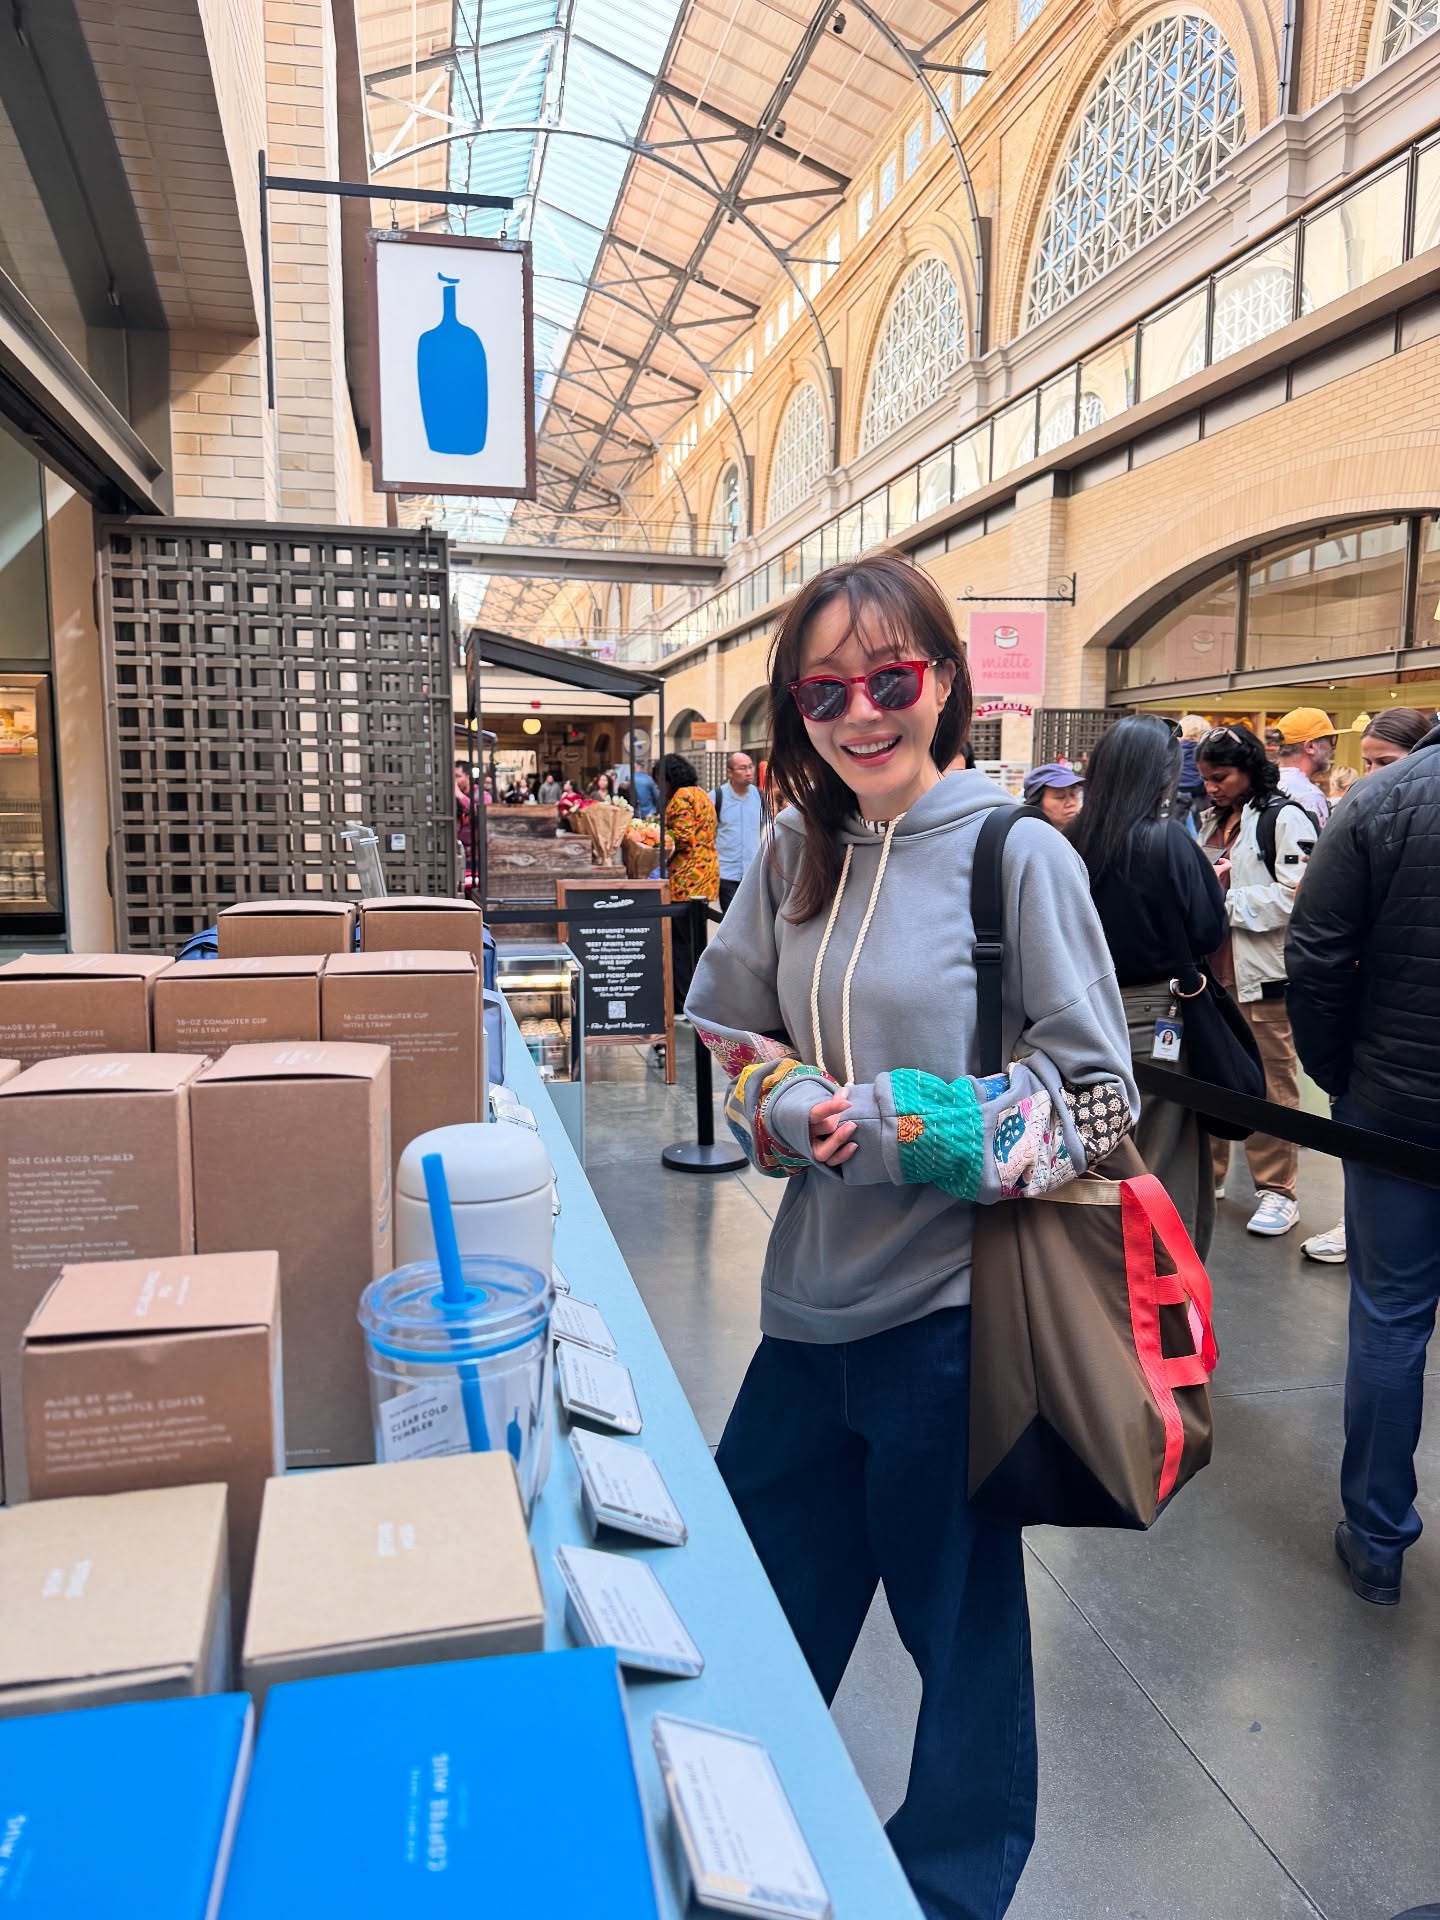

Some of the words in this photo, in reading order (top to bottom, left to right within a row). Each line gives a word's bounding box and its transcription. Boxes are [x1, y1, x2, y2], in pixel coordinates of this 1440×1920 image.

[203, 1017, 250, 1026] COMMUTER
[391, 1414, 419, 1433] CLEAR
[422, 1404, 448, 1419] COLD
[392, 1420, 433, 1442] TUMBLER
